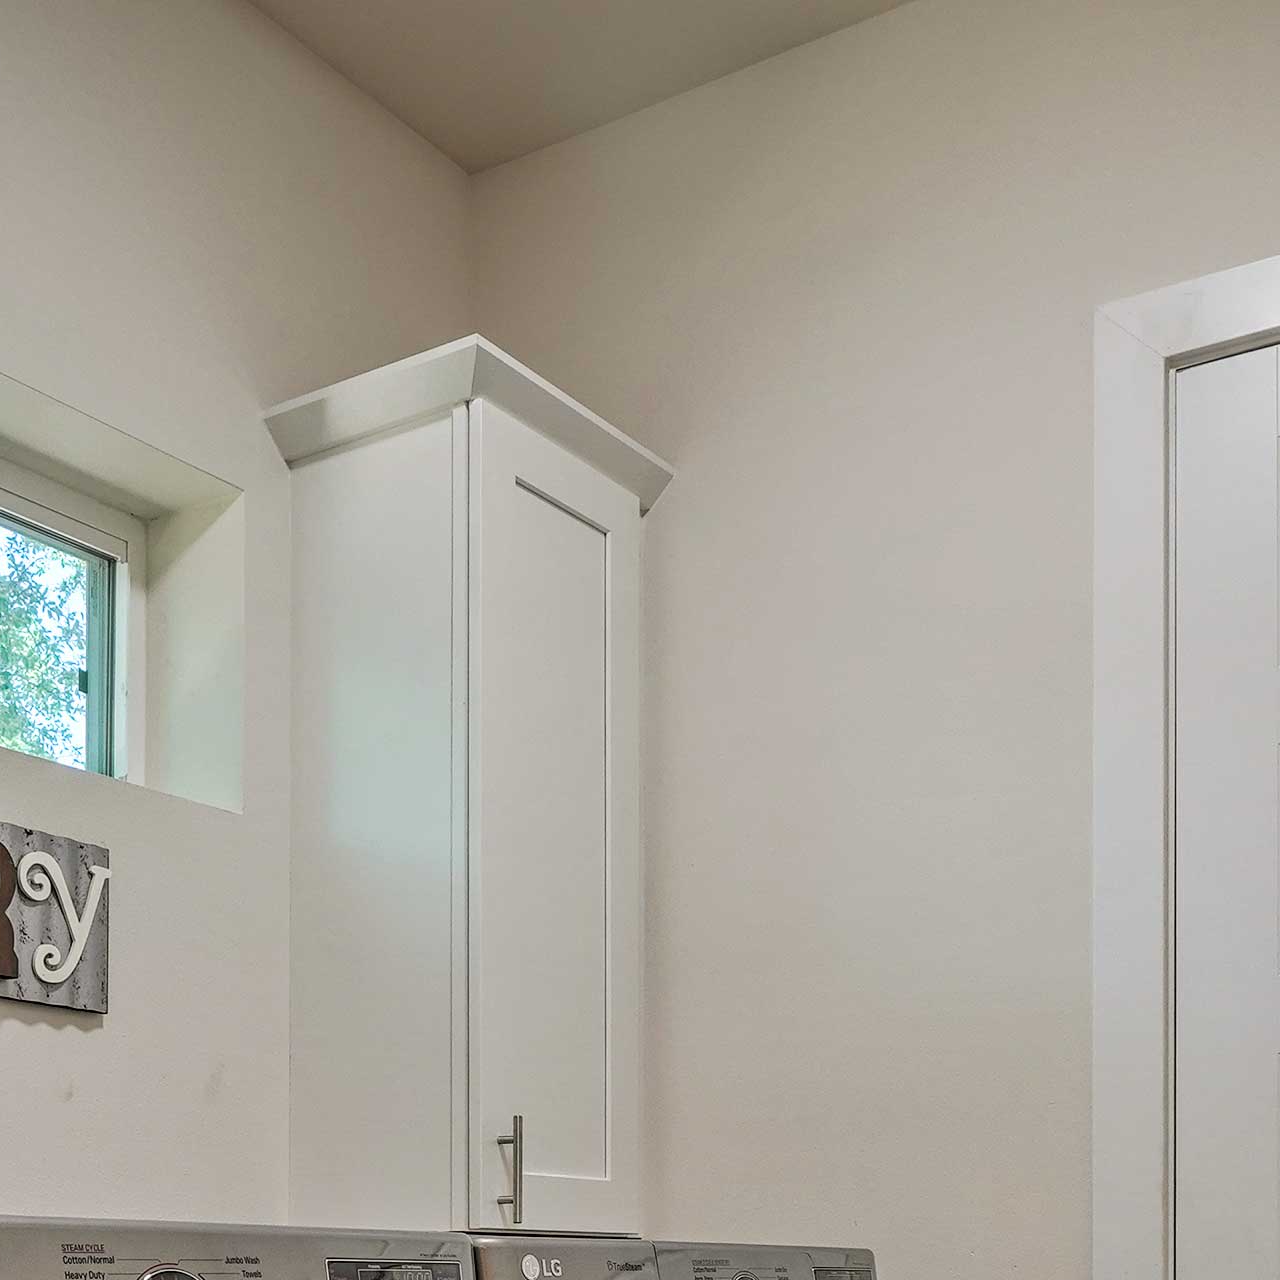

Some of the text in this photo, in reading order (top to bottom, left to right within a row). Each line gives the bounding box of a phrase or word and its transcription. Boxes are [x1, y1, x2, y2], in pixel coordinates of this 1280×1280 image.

[61, 1243, 105, 1252] STEAM CYCLE
[62, 1255, 115, 1265] Cotton/Normal
[541, 1258, 563, 1277] LG
[64, 1270, 106, 1280] Heavy Duty
